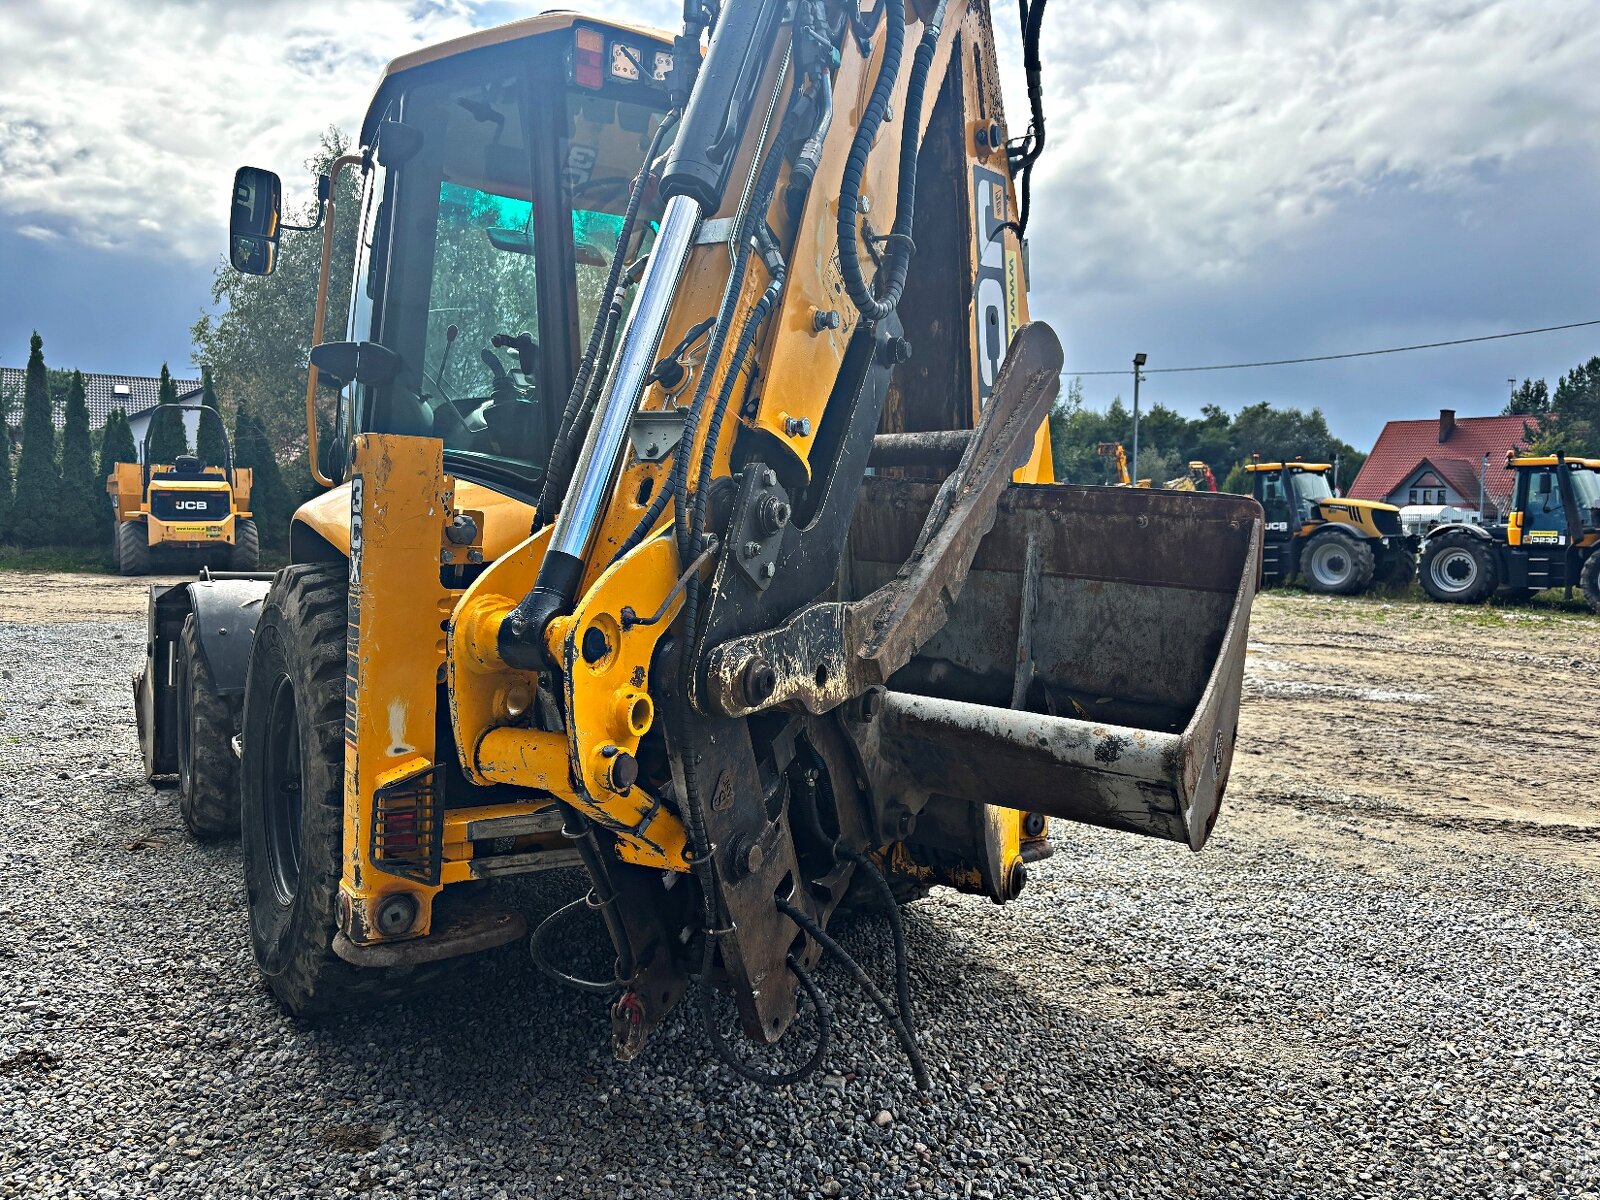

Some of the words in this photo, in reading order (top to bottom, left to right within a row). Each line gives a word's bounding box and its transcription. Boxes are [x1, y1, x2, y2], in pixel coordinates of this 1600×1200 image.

[977, 179, 1007, 414] JC
[175, 500, 208, 510] JCB
[350, 479, 363, 583] 3CX
[1264, 521, 1288, 530] JCB
